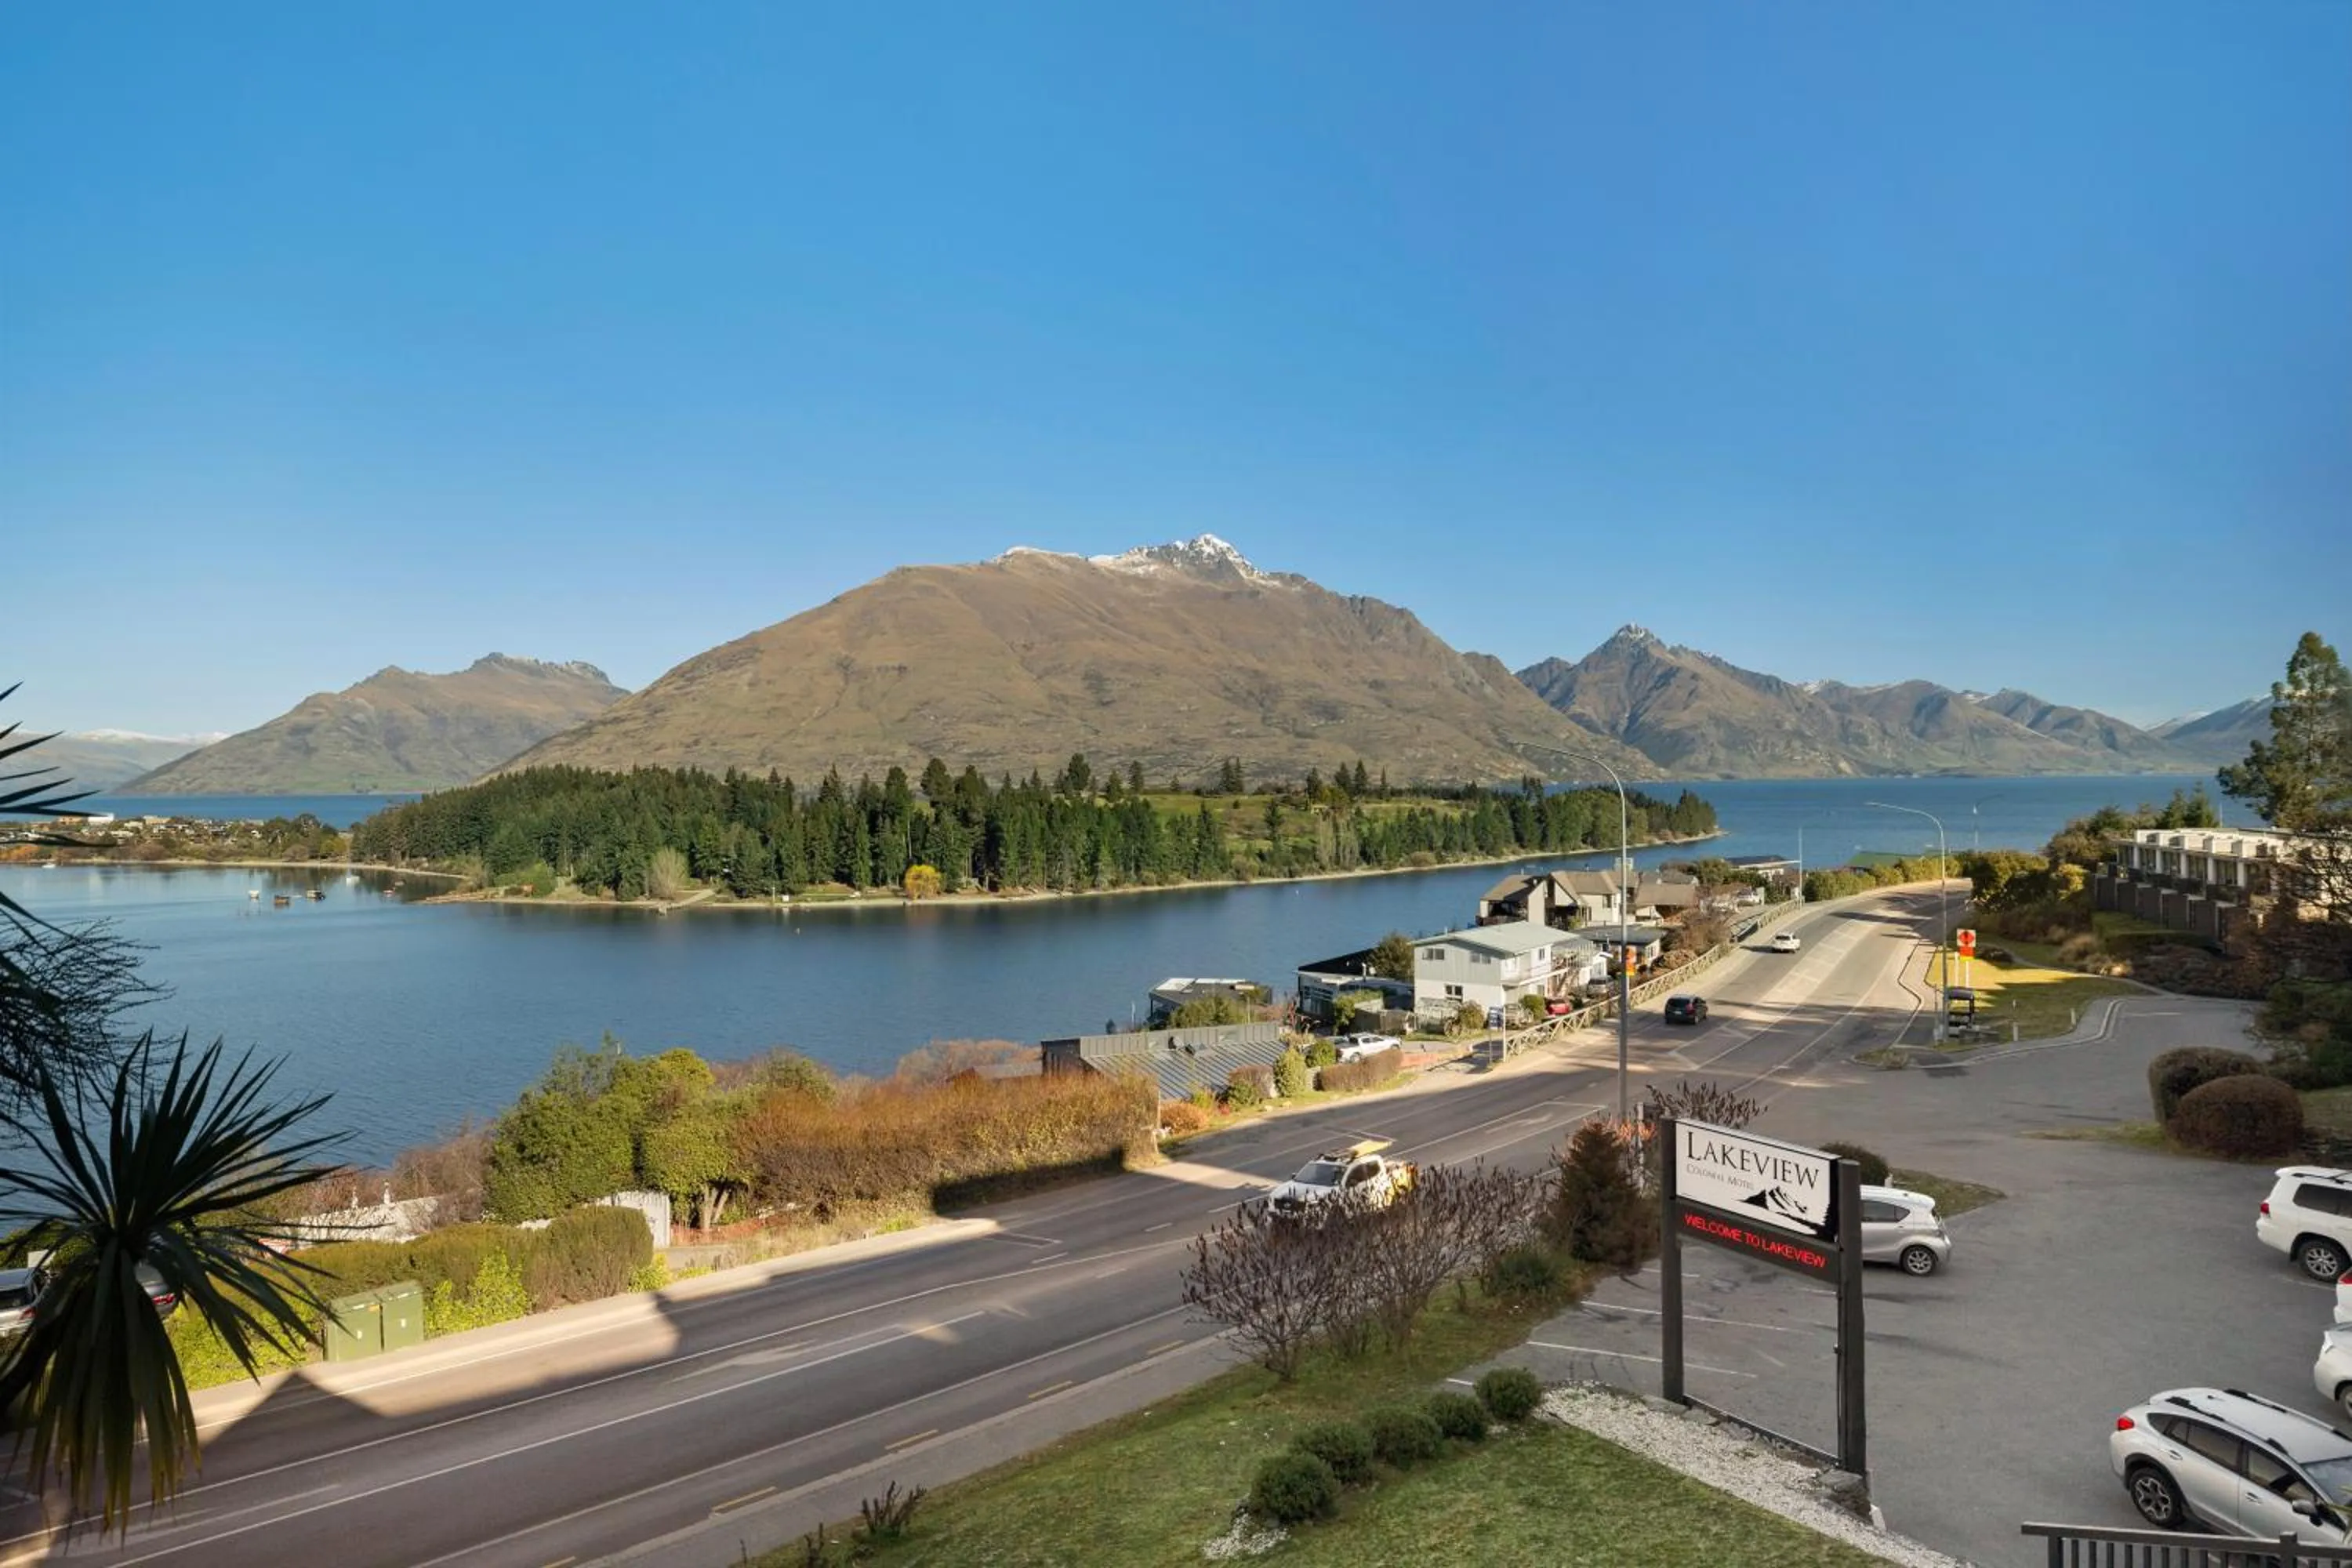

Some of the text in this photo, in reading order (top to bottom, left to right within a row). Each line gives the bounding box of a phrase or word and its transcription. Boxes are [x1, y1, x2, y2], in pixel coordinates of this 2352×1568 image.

[1687, 1131, 1819, 1189] LAKEVIEW
[1685, 1214, 1825, 1268] WELCOME TO LAKEVIEW
